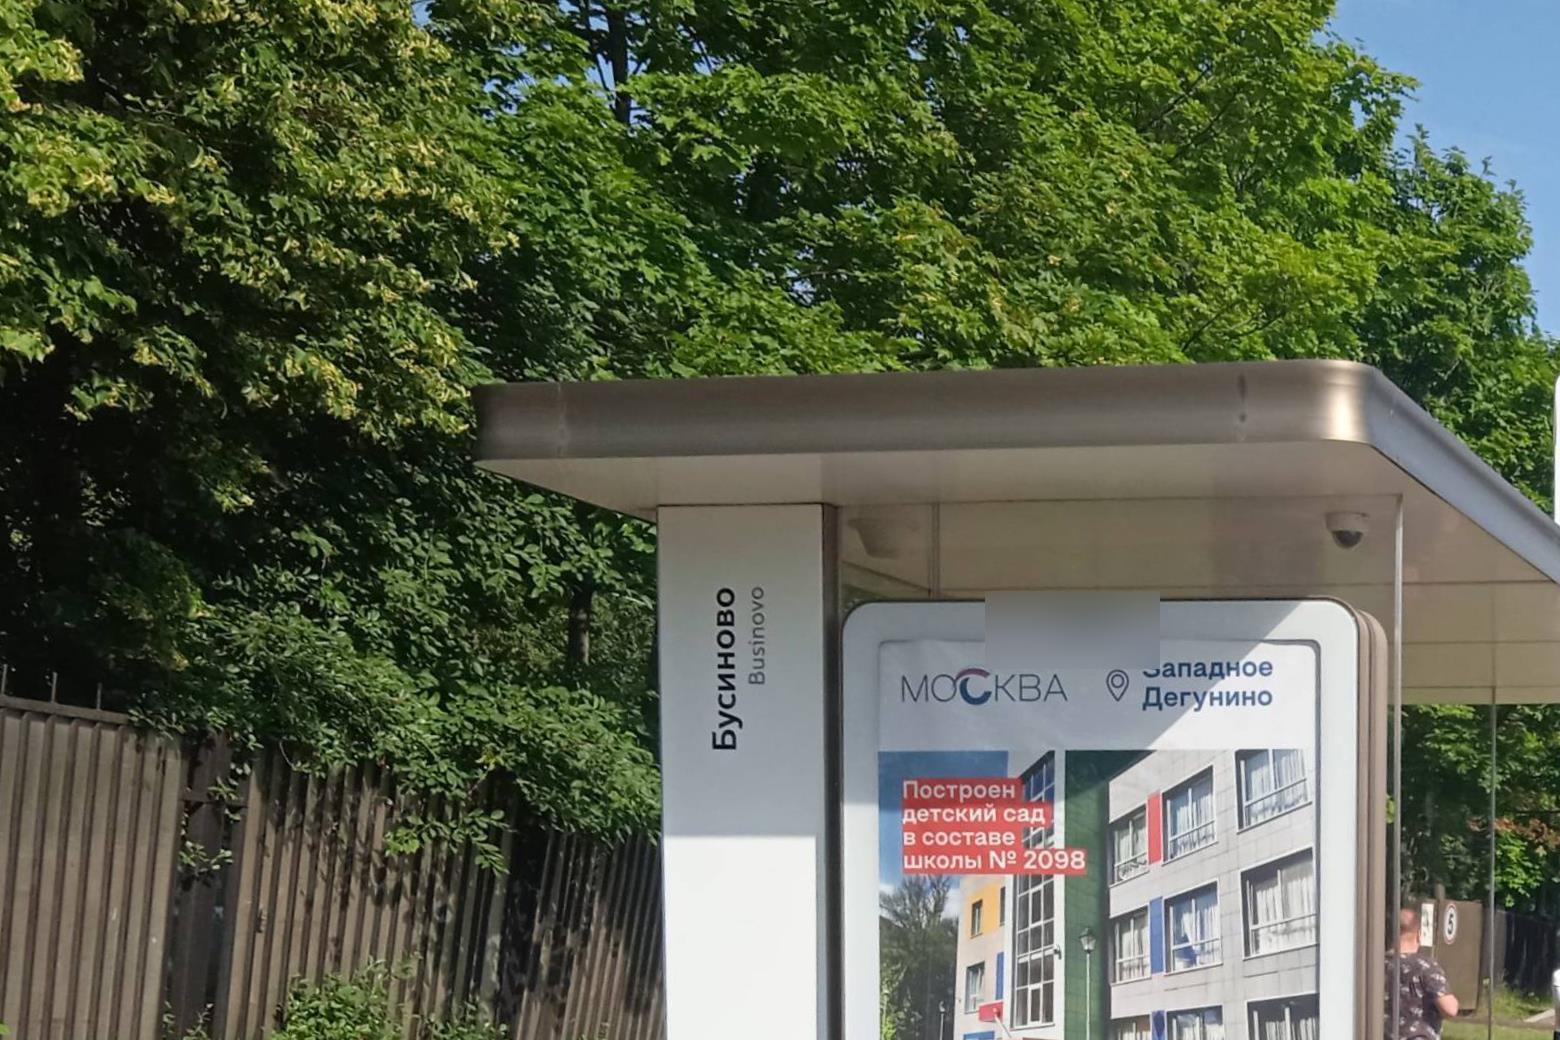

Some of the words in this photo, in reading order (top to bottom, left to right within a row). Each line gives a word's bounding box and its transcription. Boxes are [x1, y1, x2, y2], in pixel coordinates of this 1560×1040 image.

[748, 586, 766, 685] Businovo
[711, 587, 743, 750] Бусиново
[901, 668, 1068, 705] МОСКВА
[1142, 686, 1273, 712] Дегунино
[902, 780, 1016, 802] Построен
[902, 803, 997, 824] детский
[1003, 807, 1046, 824] сад
[903, 831, 916, 846] в
[922, 831, 1016, 846] составе
[903, 854, 982, 870] школы
[989, 850, 1017, 869] №
[1023, 850, 1086, 870] 2098
[1447, 913, 1454, 935] 5
